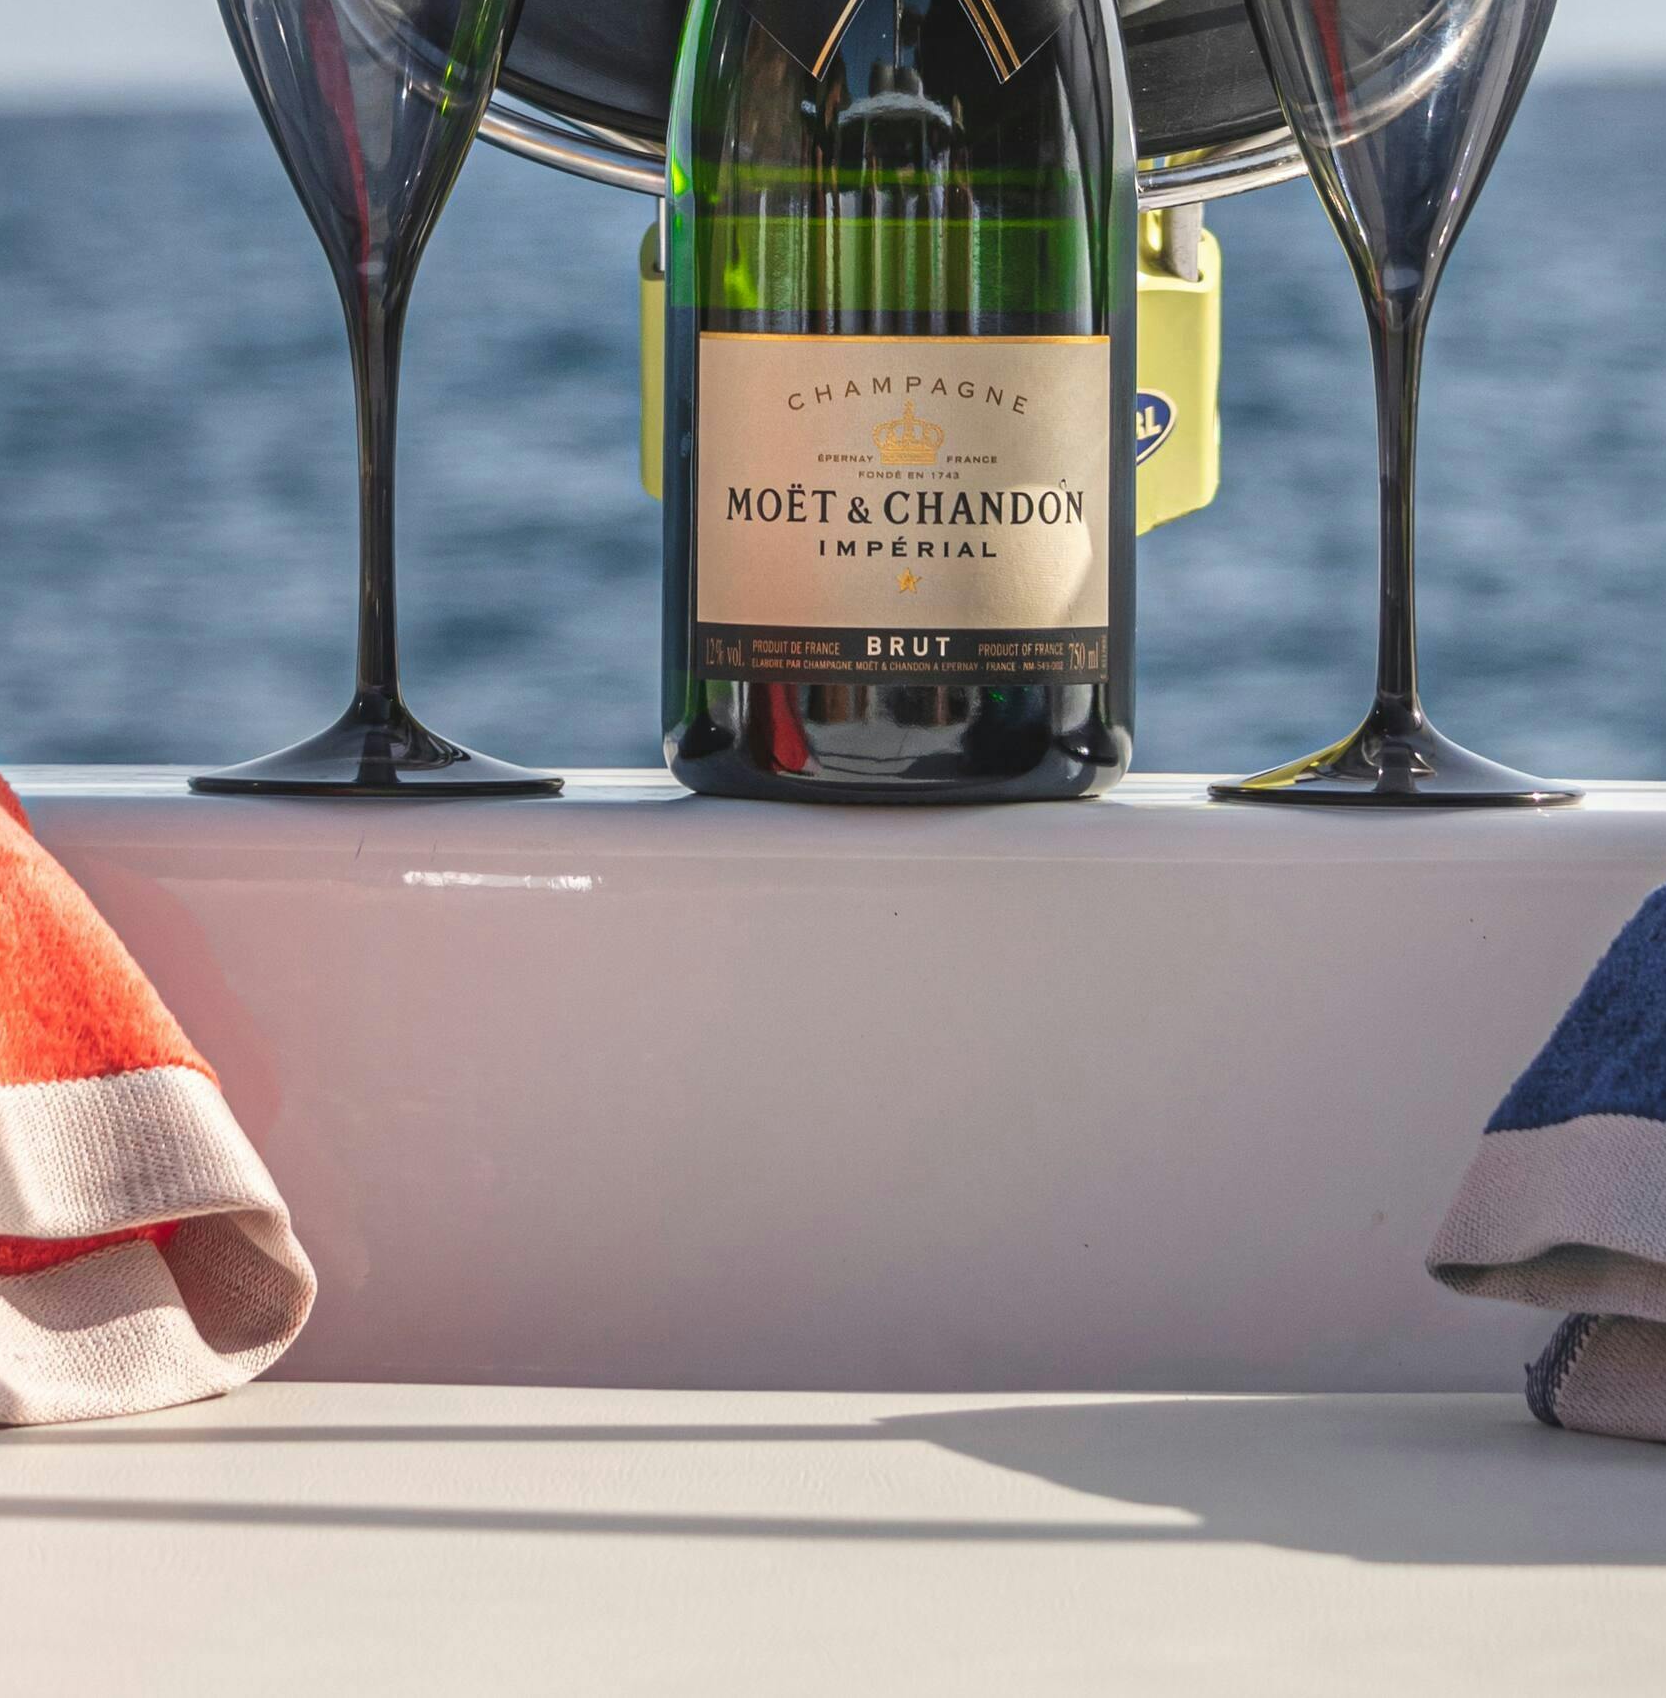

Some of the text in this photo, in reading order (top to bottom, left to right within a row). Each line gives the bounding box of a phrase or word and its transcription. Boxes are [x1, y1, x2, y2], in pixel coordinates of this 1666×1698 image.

[788, 376, 1028, 415] CHAMPAGNE
[817, 453, 998, 464] ÉPERNAY FRANCE
[858, 469, 960, 480] FONDÉ EN 1743
[726, 483, 1084, 525] MOËT & CHANDON
[819, 536, 997, 558] IMPÉRIAL
[705, 638, 745, 667] 12% vol.
[752, 639, 840, 656] PRODUIT DE FRANCE
[867, 636, 951, 656] BRUT
[978, 642, 1064, 657] PRODUCT OF FRANCE
[1068, 641, 1085, 671] 750
[1088, 640, 1099, 670] ml
[785, 659, 801, 670] PAR
[803, 659, 853, 671] CHAMPAGNE
[881, 660, 888, 671] &
[889, 661, 931, 671] CHANDON
[985, 661, 1016, 672] FRANCE
